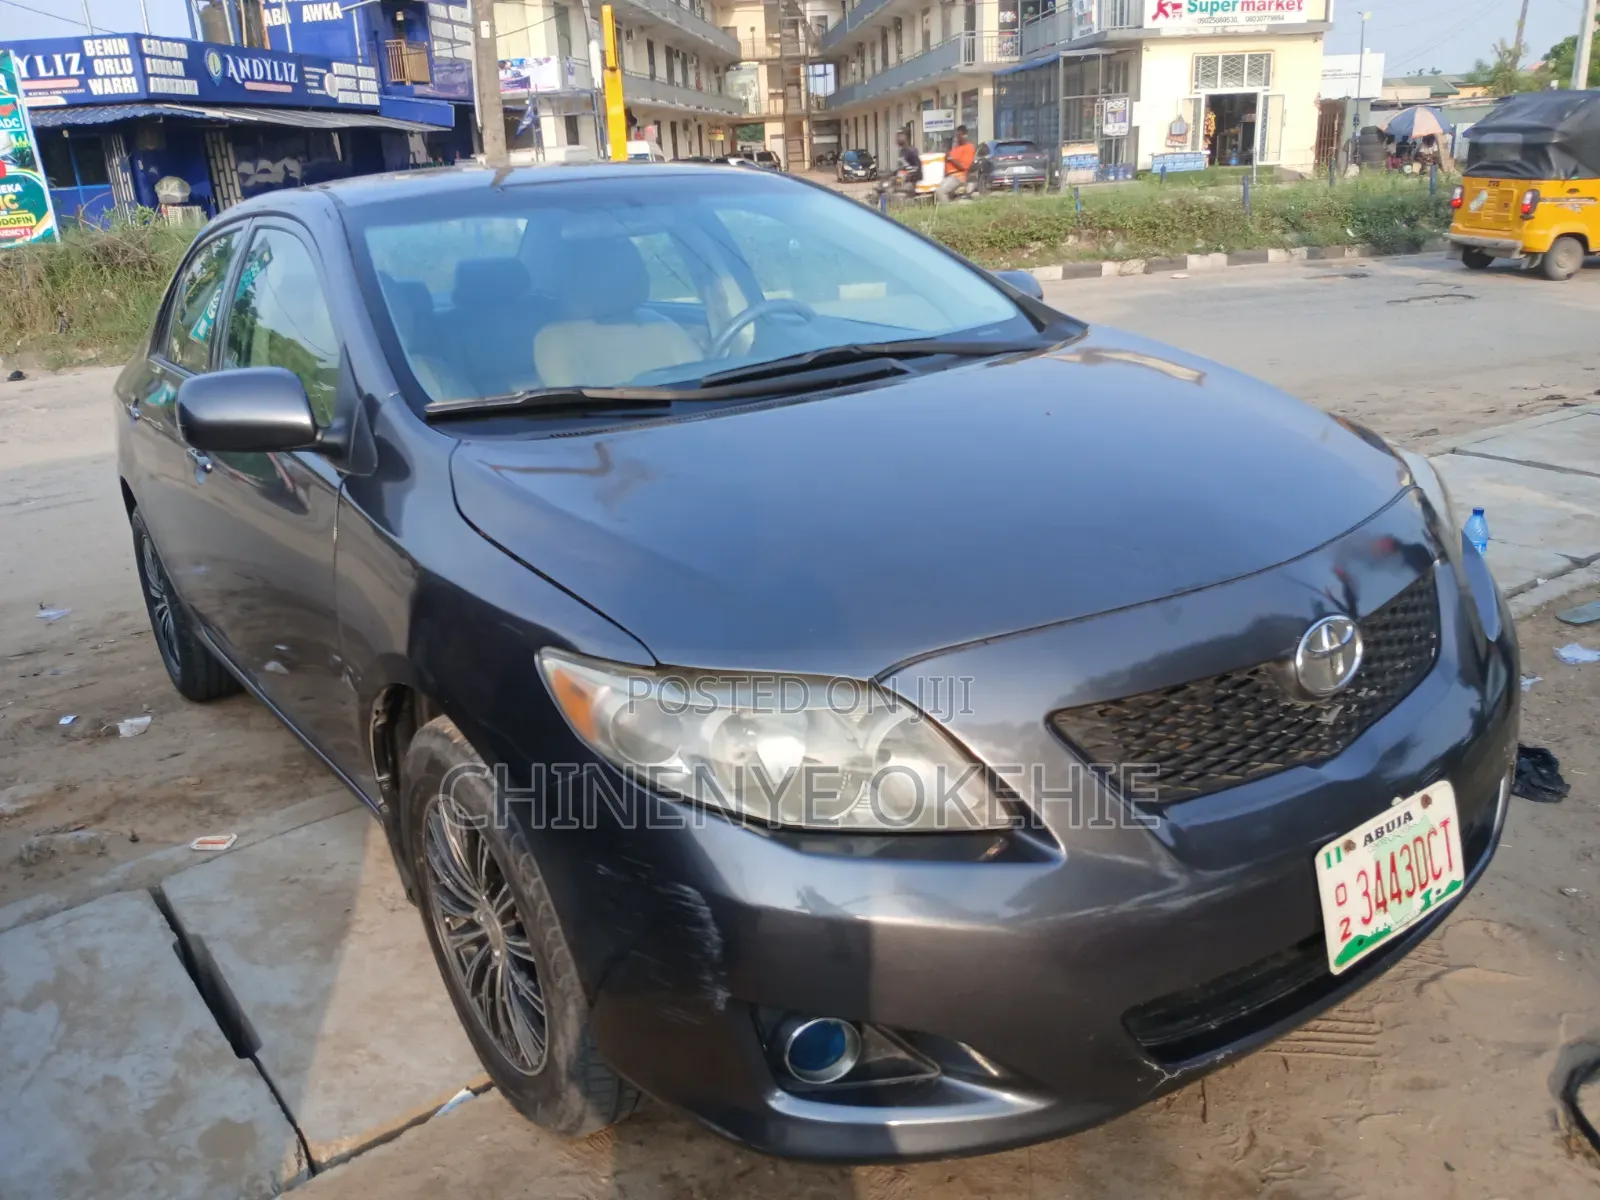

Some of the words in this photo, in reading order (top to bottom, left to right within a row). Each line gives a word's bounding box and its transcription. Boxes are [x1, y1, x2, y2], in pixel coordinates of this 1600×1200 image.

[302, 2, 343, 23] AWKA
[83, 38, 130, 57] BENIN
[93, 57, 134, 76] ORLU
[222, 52, 299, 84] ANDYLIZ
[87, 76, 139, 96] WARRI
[0, 182, 24, 195] EKA
[0, 215, 33, 227] DOFIN
[1363, 810, 1414, 848] ABUJA
